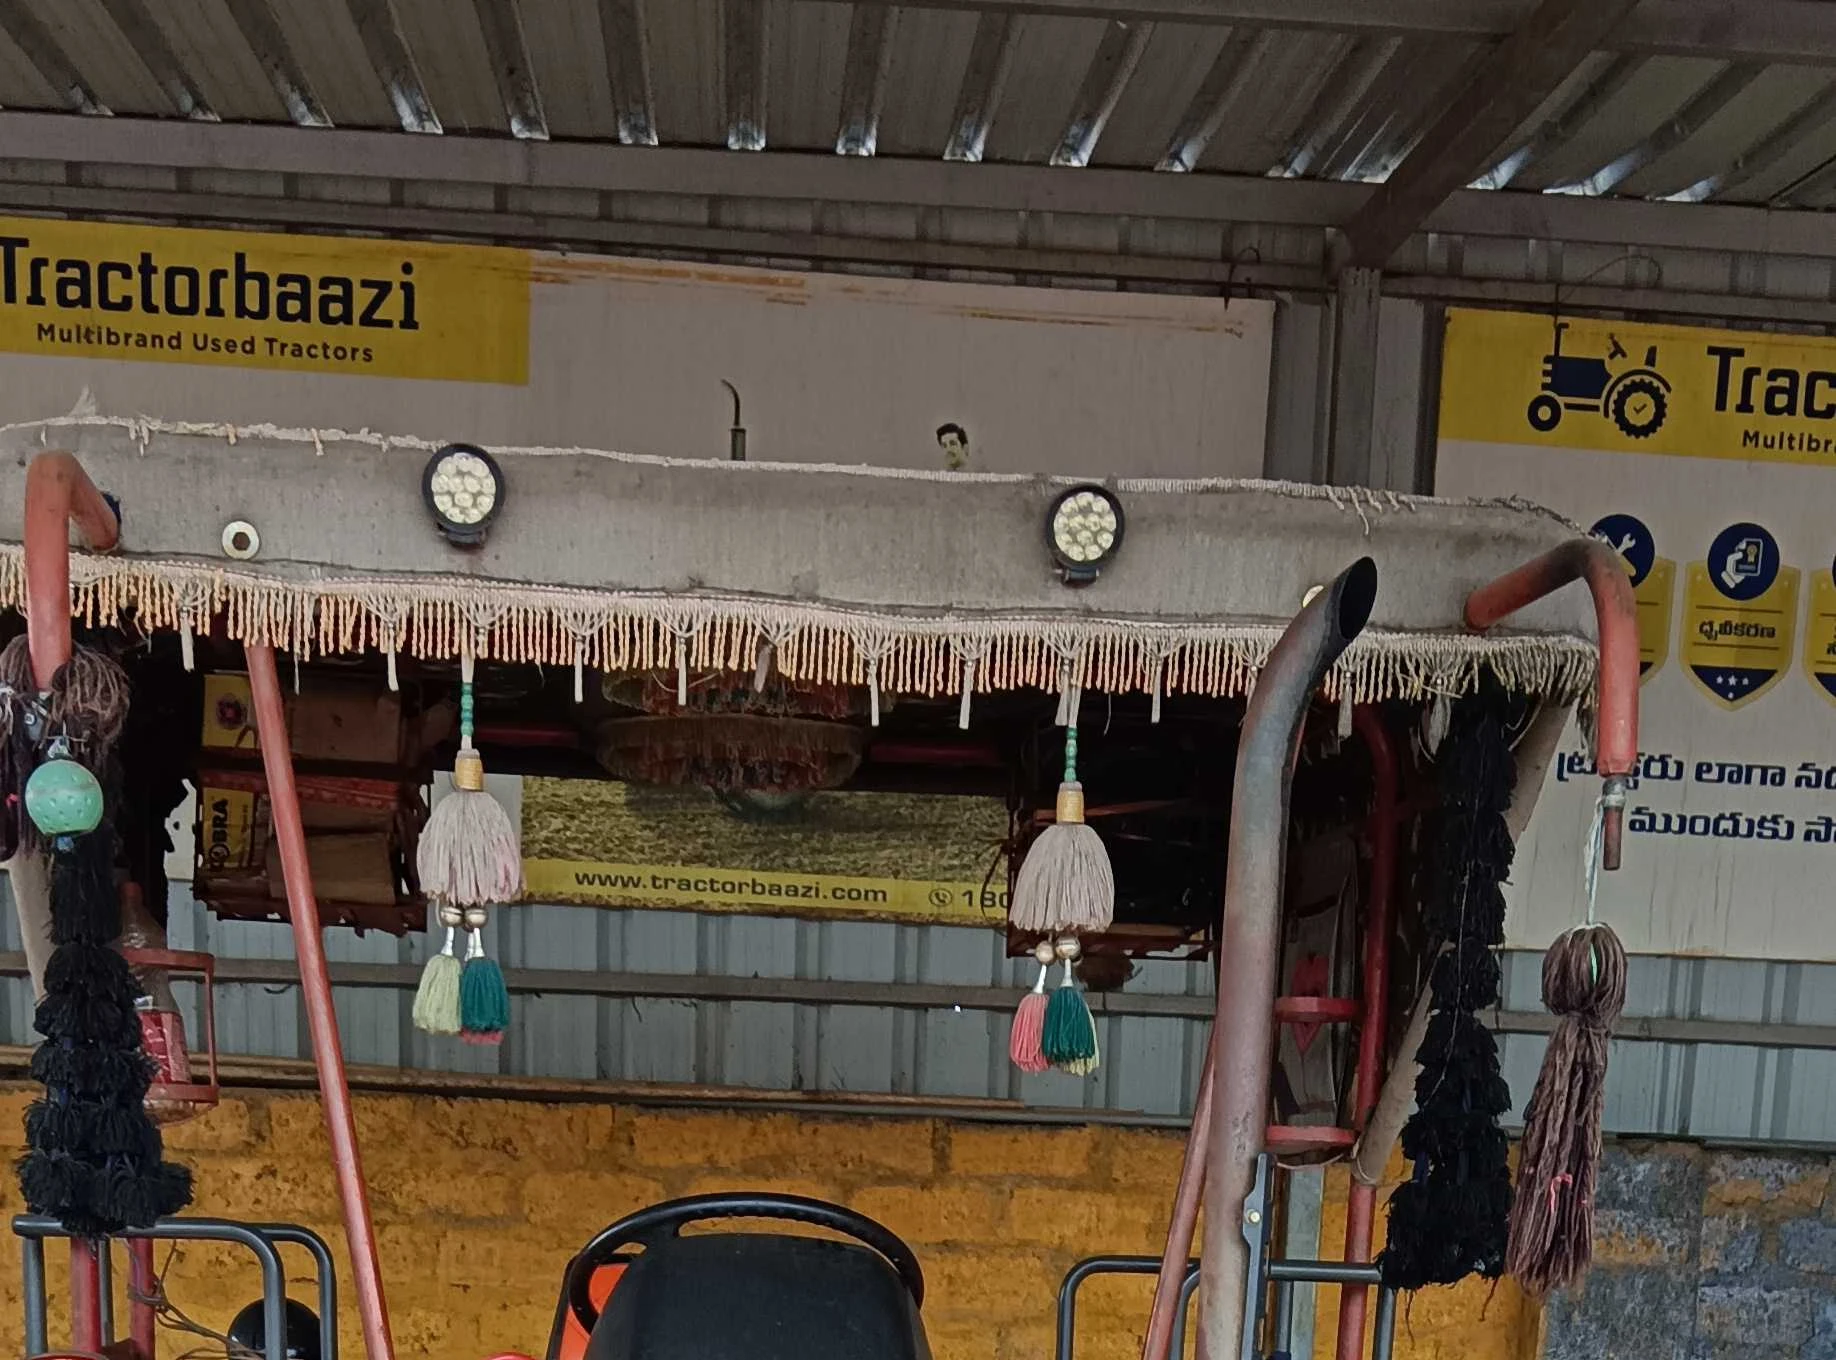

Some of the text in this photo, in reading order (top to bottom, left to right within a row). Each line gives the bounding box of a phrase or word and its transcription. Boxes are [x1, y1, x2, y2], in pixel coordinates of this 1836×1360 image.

[0, 236, 419, 331] Tractorbaazi
[36, 323, 374, 363] Multibrand Used Tractors
[1742, 429, 1836, 454] Multibr
[1694, 760, 1786, 787] లాగా
[1628, 806, 1795, 841] ముందుకు
[574, 869, 888, 903] www.tractorbaazi.com
